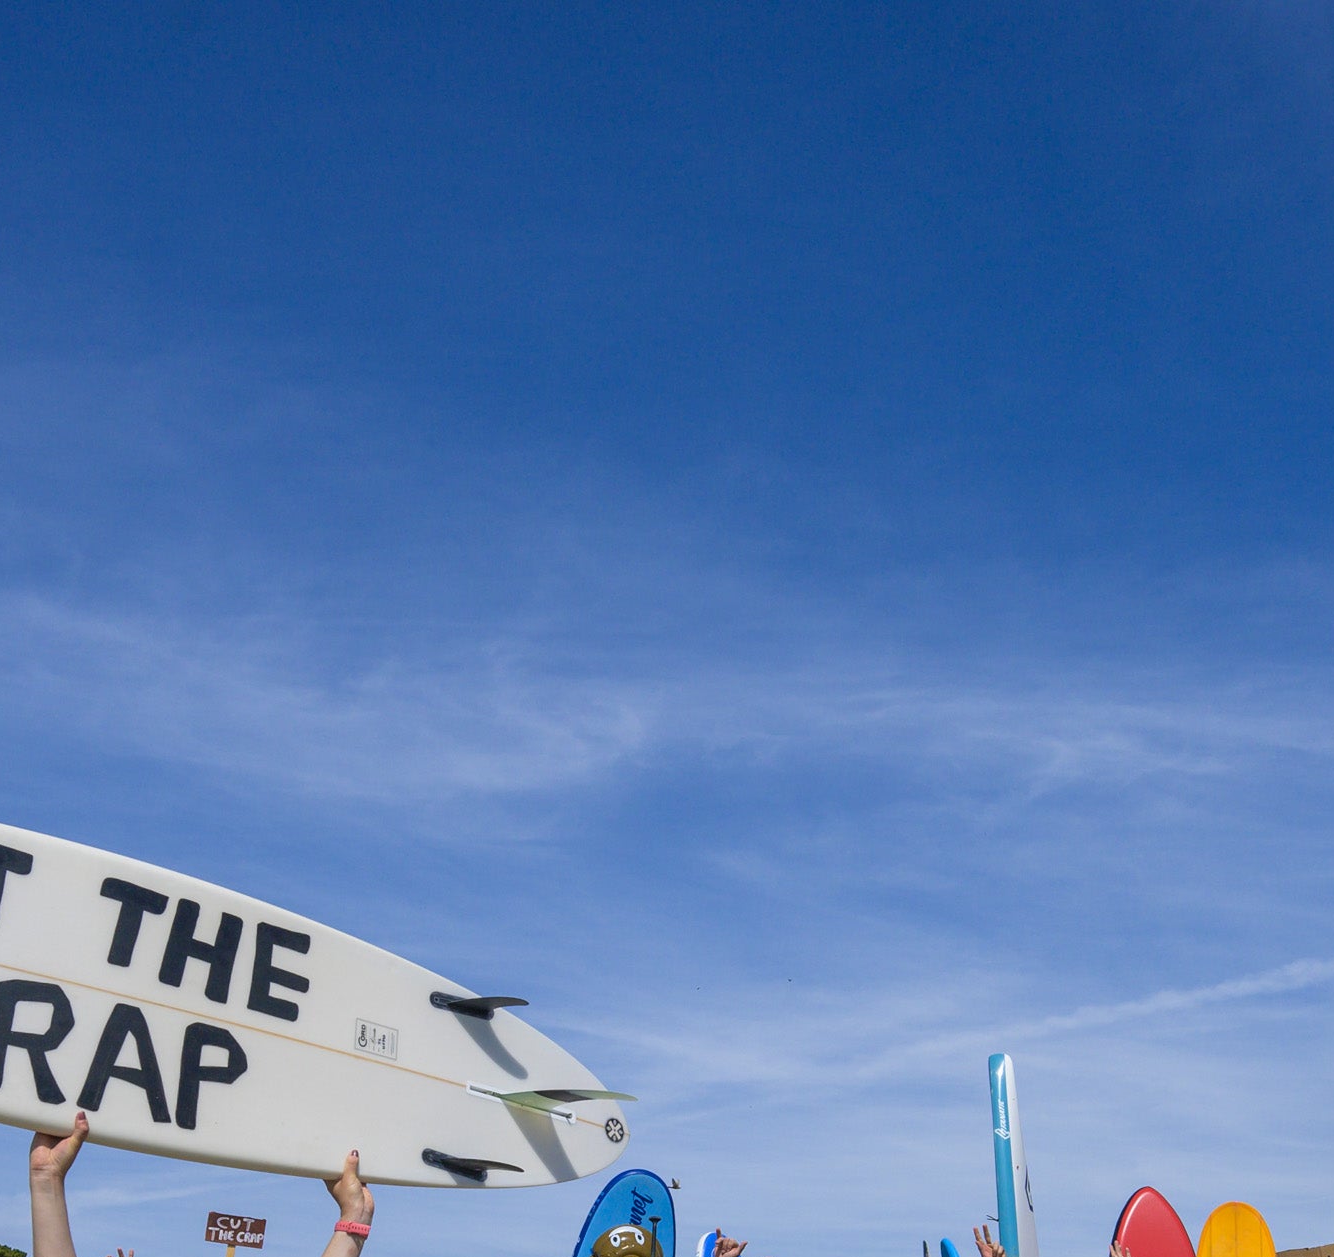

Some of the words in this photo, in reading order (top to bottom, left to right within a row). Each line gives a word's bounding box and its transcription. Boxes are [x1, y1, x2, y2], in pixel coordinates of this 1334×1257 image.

[99, 876, 311, 1022] THE
[216, 1217, 255, 1232] CUT
[208, 1226, 234, 1241] THE
[236, 1230, 264, 1244] CRAP
